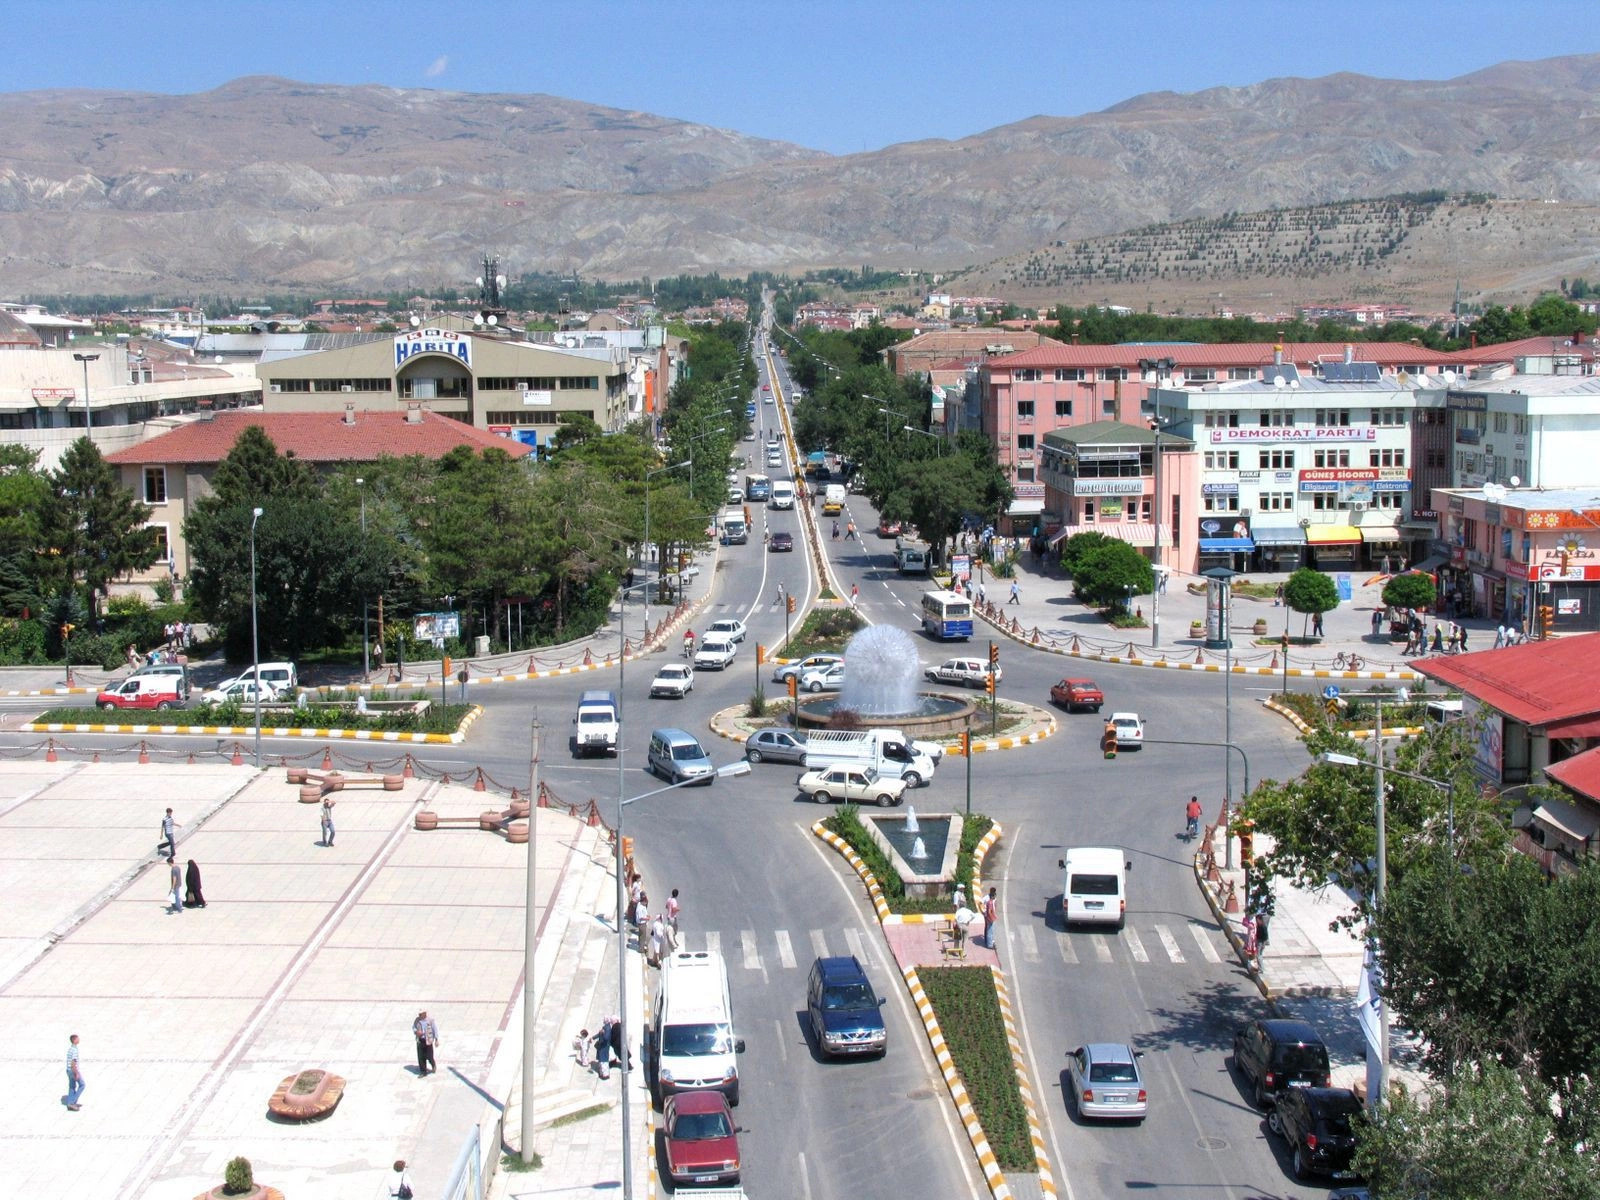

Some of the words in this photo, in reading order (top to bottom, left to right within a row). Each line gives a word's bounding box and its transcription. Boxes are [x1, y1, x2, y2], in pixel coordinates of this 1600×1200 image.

[1228, 429, 1312, 438] DEMOKRAT
[1316, 429, 1361, 437] PARTİ
[1305, 470, 1335, 480] GÜNEŞ
[1337, 470, 1375, 479] SİGORTA
[1304, 483, 1336, 491] Bilgisayar
[1376, 482, 1408, 490] Elektronik
